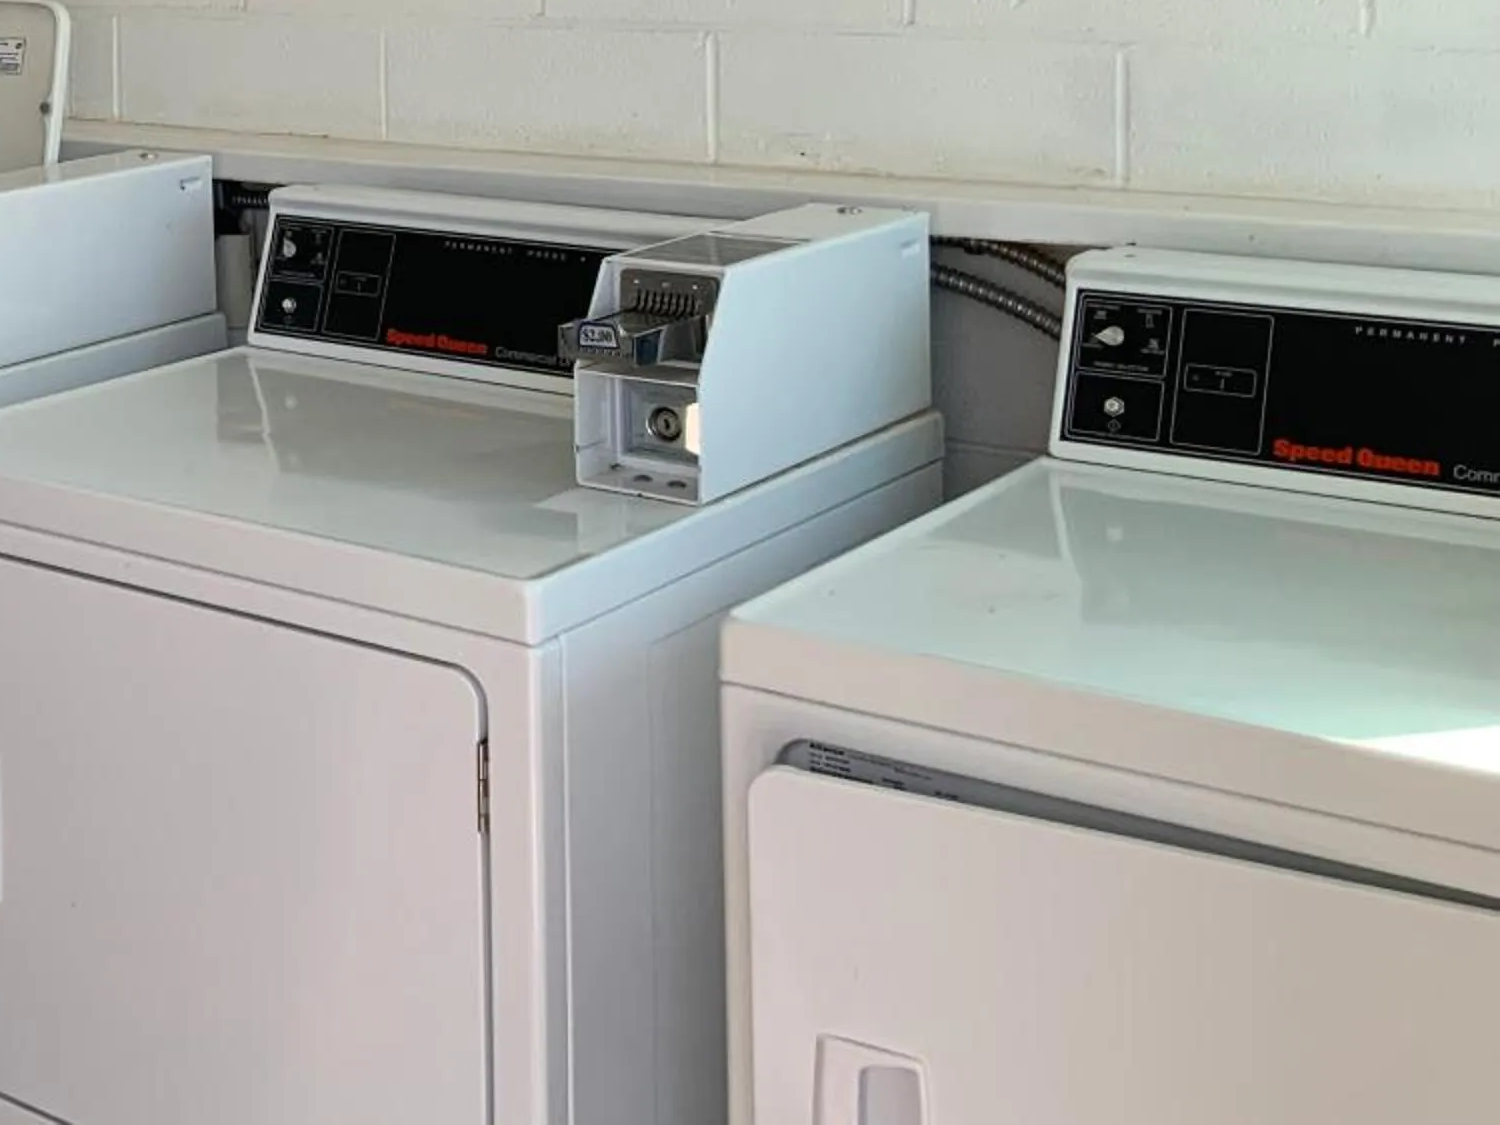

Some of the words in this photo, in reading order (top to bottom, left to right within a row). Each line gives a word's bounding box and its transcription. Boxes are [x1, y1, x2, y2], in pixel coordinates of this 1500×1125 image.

[387, 328, 436, 348] Speed
[437, 335, 489, 355] Queen
[1355, 326, 1466, 344] PERMANENT
[1273, 439, 1352, 465] Speed
[1356, 447, 1440, 476] Queen
